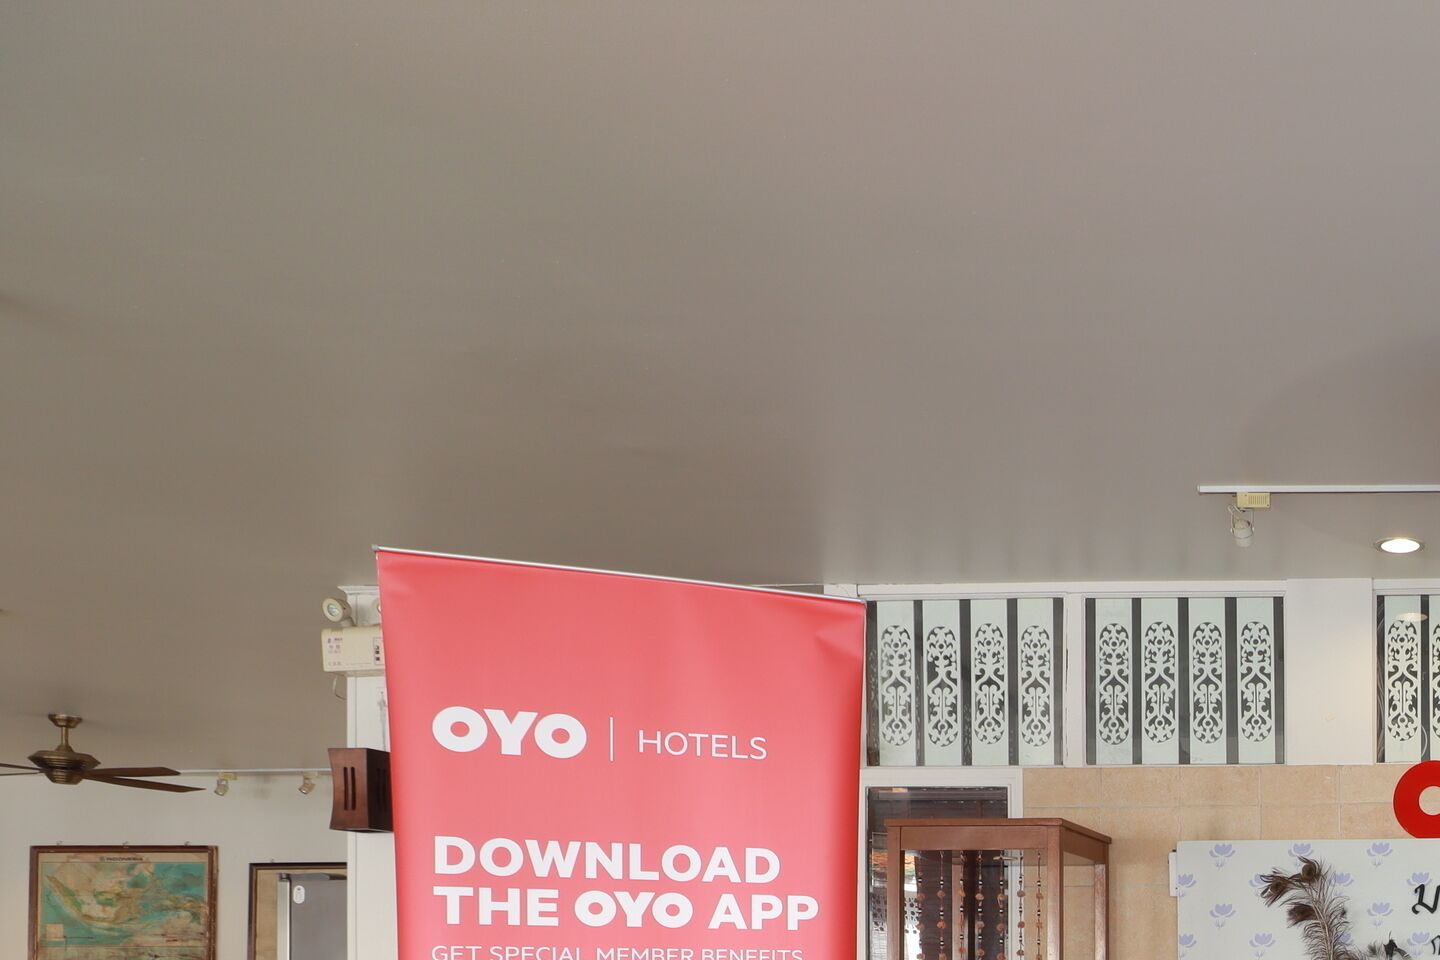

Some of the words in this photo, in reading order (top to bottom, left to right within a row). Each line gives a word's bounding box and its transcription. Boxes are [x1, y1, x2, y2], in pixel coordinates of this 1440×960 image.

[432, 706, 587, 759] OYO
[638, 729, 768, 760] HOTELS
[433, 835, 781, 884] DOWNLOAD
[433, 886, 559, 926] THE
[574, 890, 694, 929] OYO
[708, 893, 819, 931] APP
